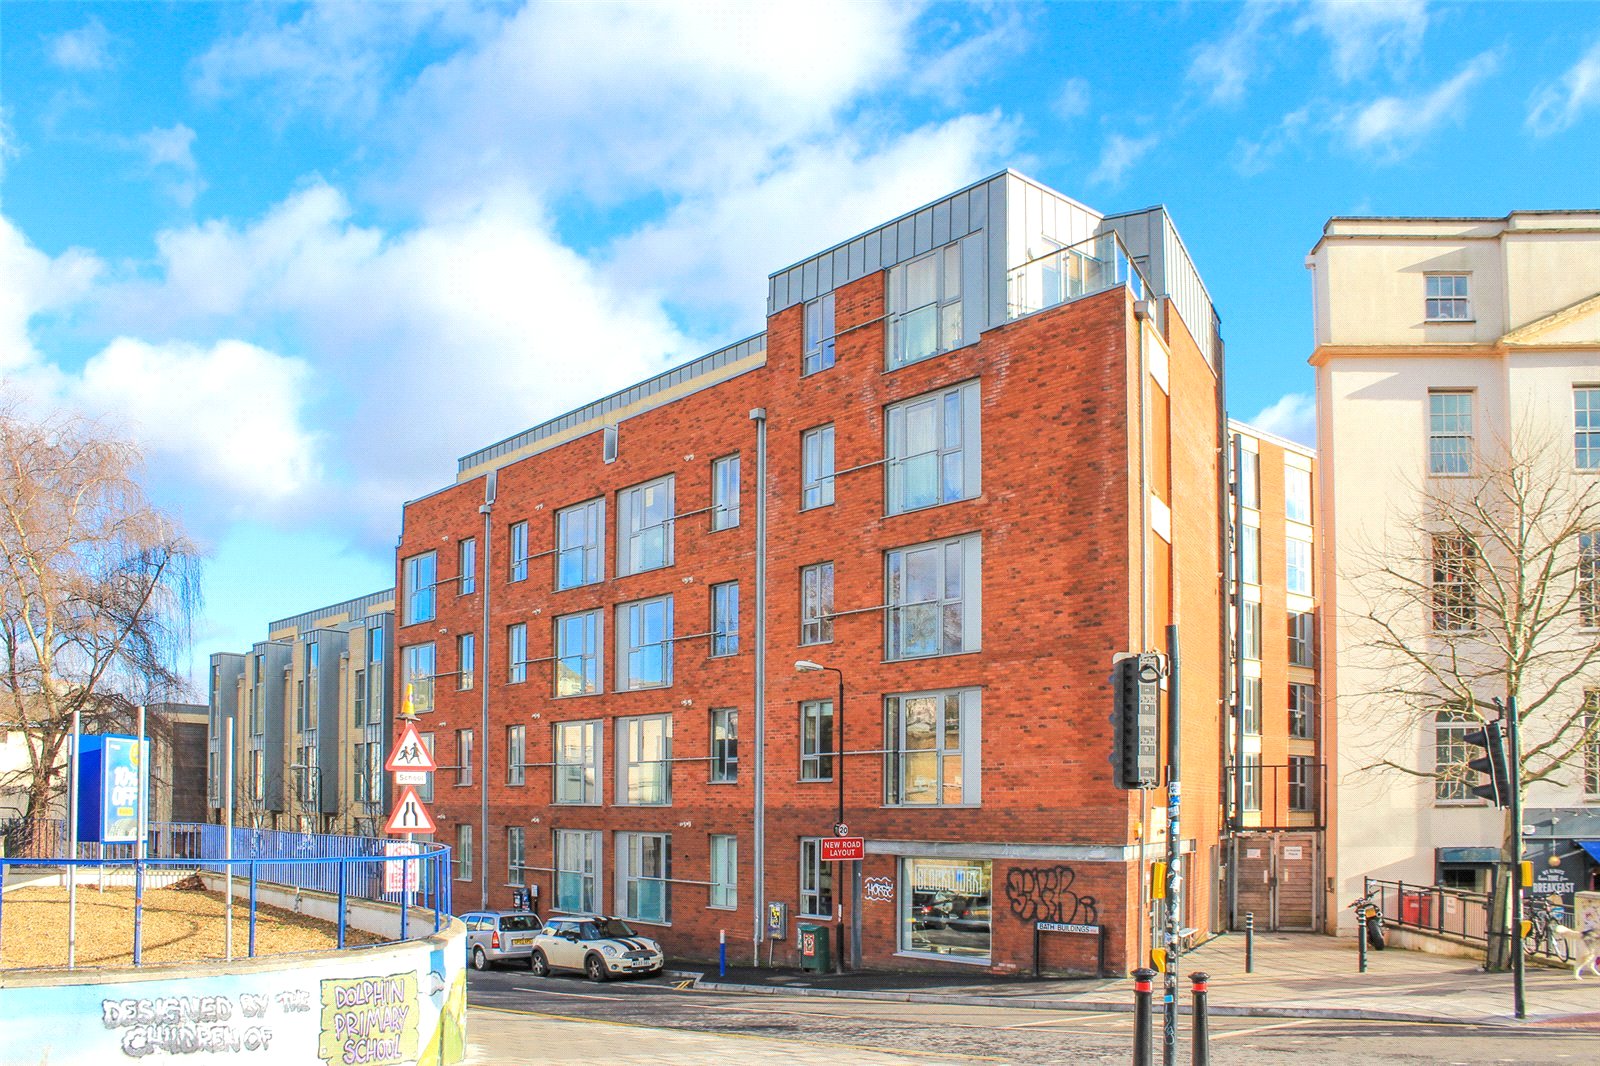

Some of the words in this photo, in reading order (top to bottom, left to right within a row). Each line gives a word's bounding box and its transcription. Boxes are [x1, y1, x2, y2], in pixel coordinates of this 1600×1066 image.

[112, 786, 138, 806] OFF
[829, 849, 855, 857] LAYOUT
[917, 868, 979, 893] BLOCKWORK
[1533, 882, 1575, 893] BREAKFAST
[102, 996, 233, 1029] DESIGNED
[239, 993, 269, 1018] BY
[276, 989, 311, 1013] THE
[334, 978, 404, 1009] DOLPHIN
[334, 1005, 409, 1041] PRIMARY
[122, 1025, 241, 1058] CHILDREN
[244, 1025, 273, 1051] OF
[342, 1033, 402, 1065] SCHOOL
